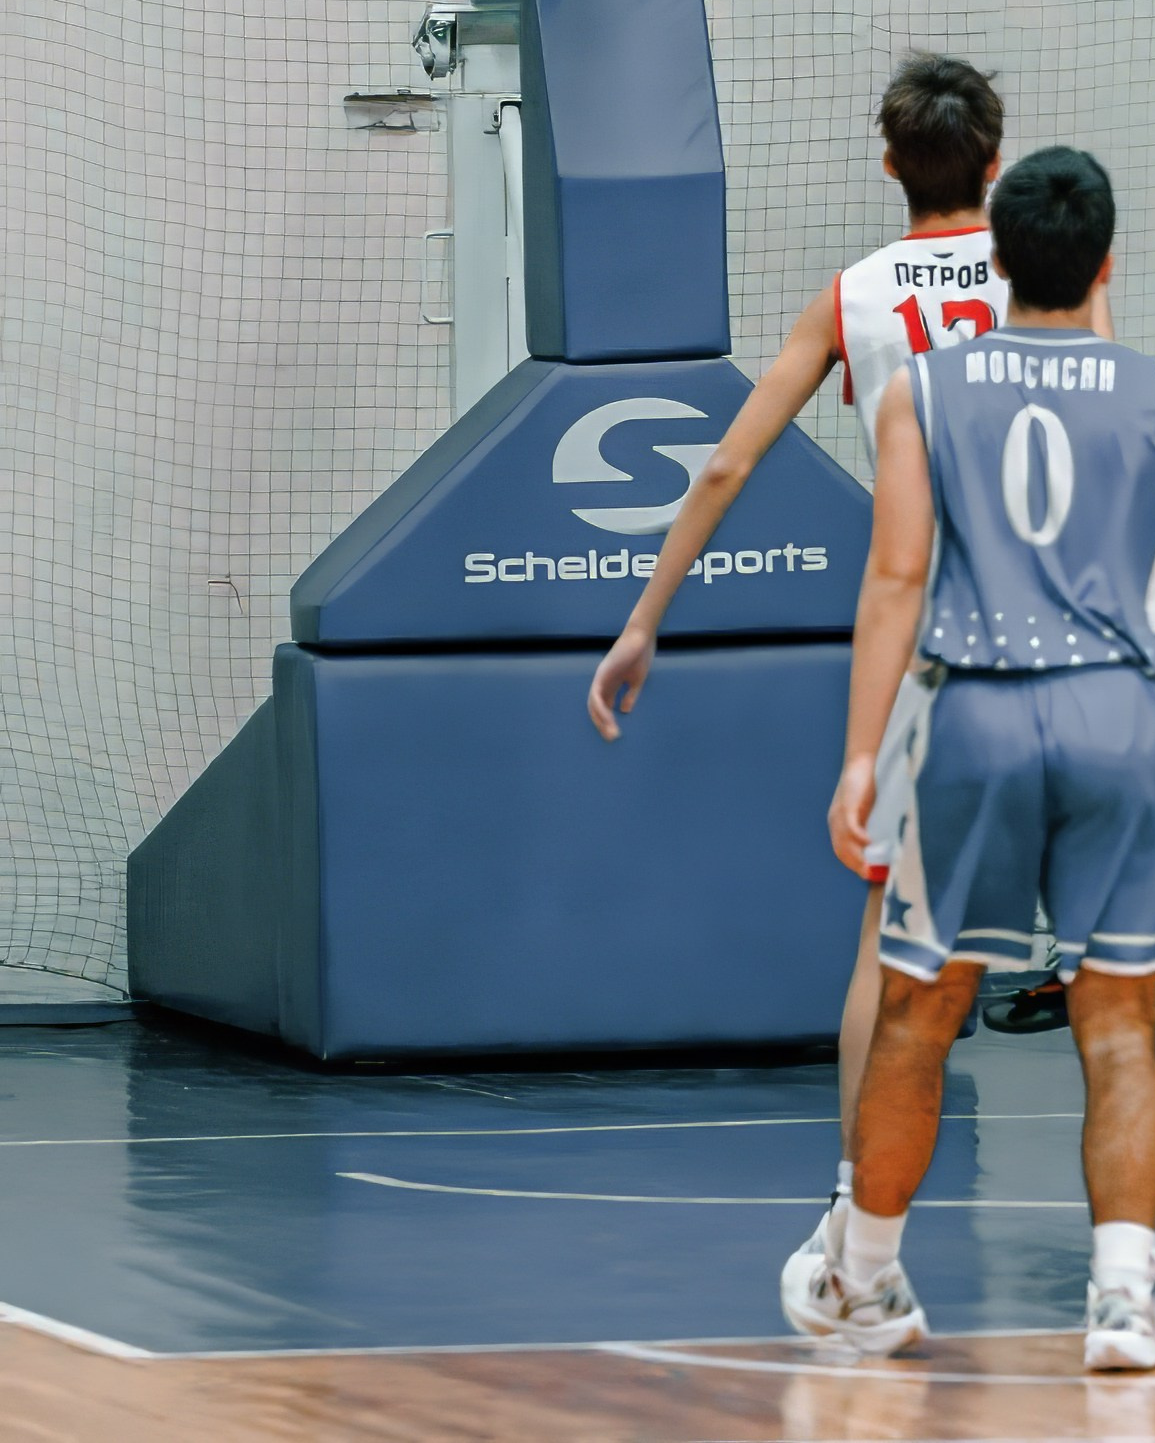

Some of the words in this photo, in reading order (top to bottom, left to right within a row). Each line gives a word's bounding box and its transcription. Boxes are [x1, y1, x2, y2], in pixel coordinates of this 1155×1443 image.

[895, 261, 988, 289] ПЕТРОВ
[1002, 403, 1074, 545] 0
[464, 542, 829, 584] Scheldeports
